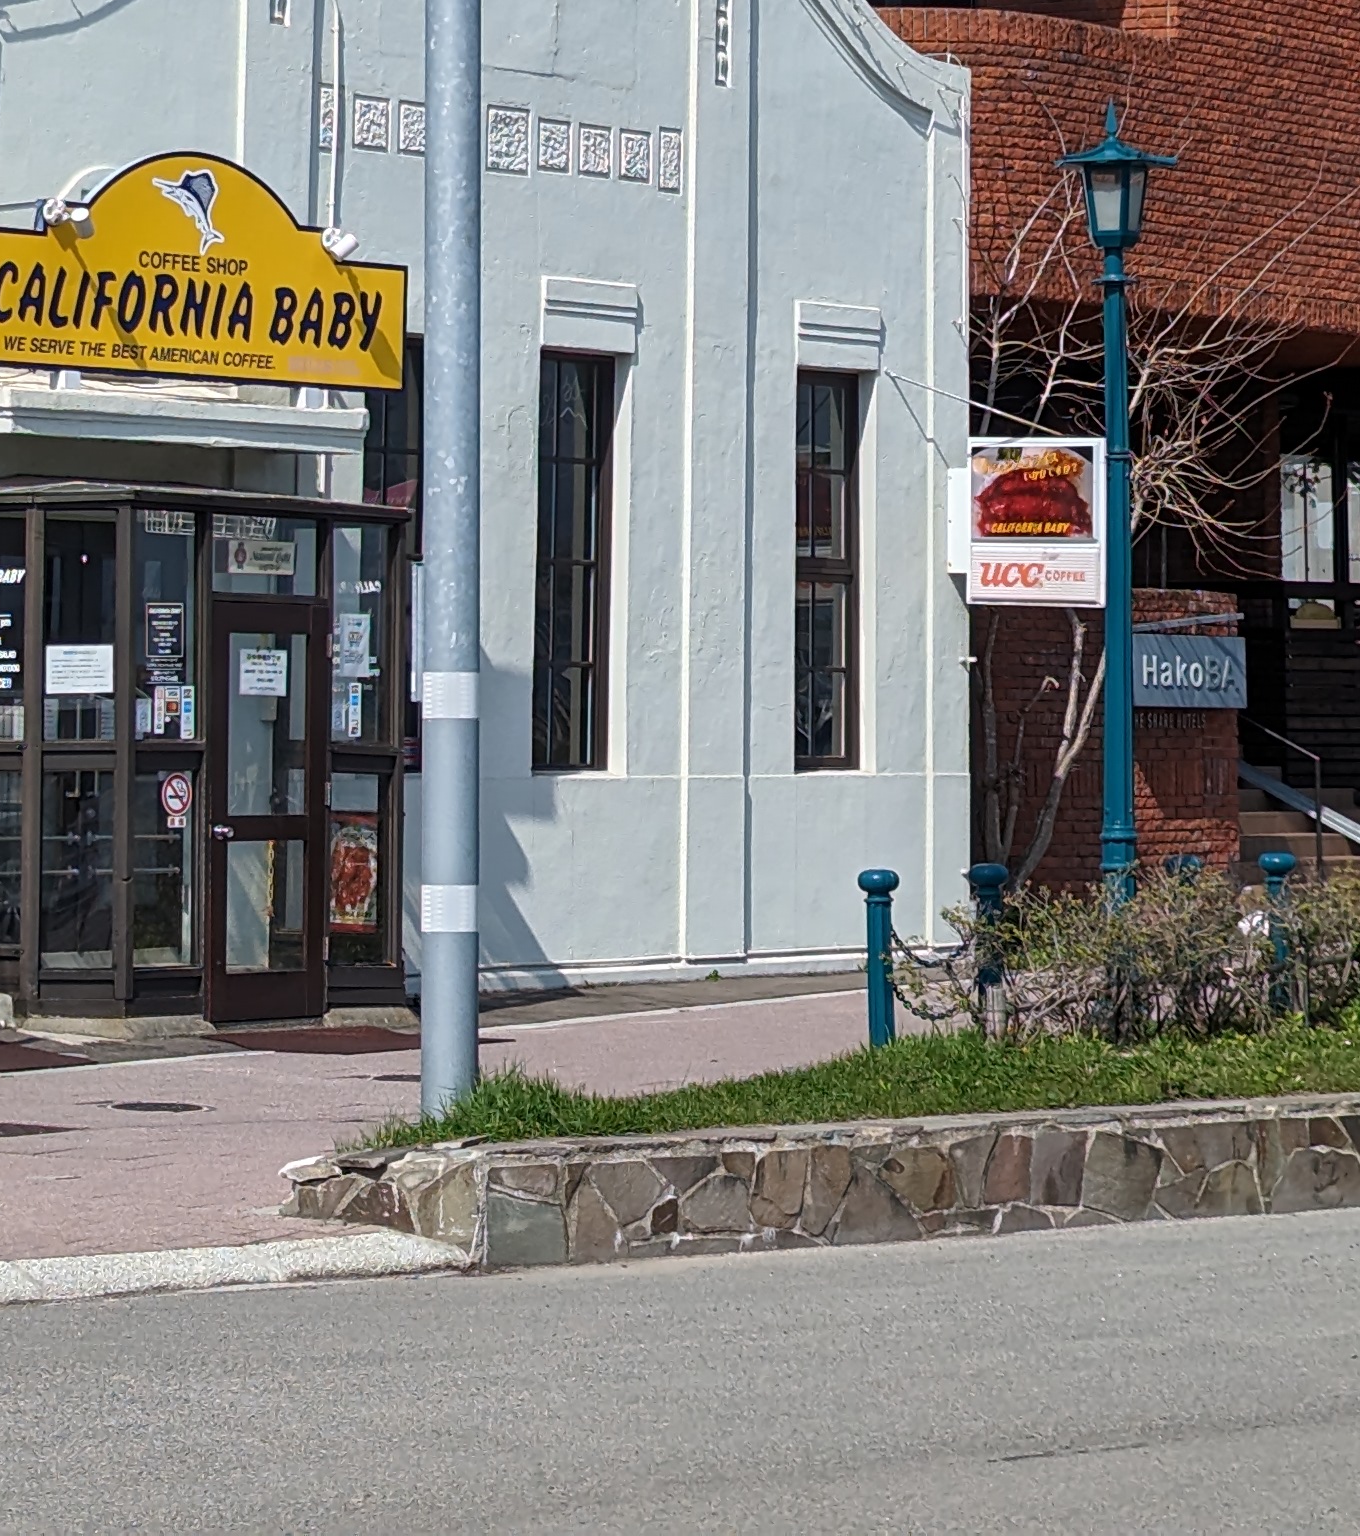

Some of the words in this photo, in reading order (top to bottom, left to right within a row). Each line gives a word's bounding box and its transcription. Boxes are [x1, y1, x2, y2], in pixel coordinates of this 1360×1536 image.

[138, 250, 201, 273] COFFEE
[206, 256, 248, 276] SHOP
[268, 286, 383, 352] BABY
[4, 336, 29, 352] WE
[30, 337, 76, 356] SERVE
[80, 341, 106, 358] THE
[111, 343, 146, 360] BEST
[149, 346, 219, 365] AMERICAN
[1045, 570, 1086, 582] COFFEE
